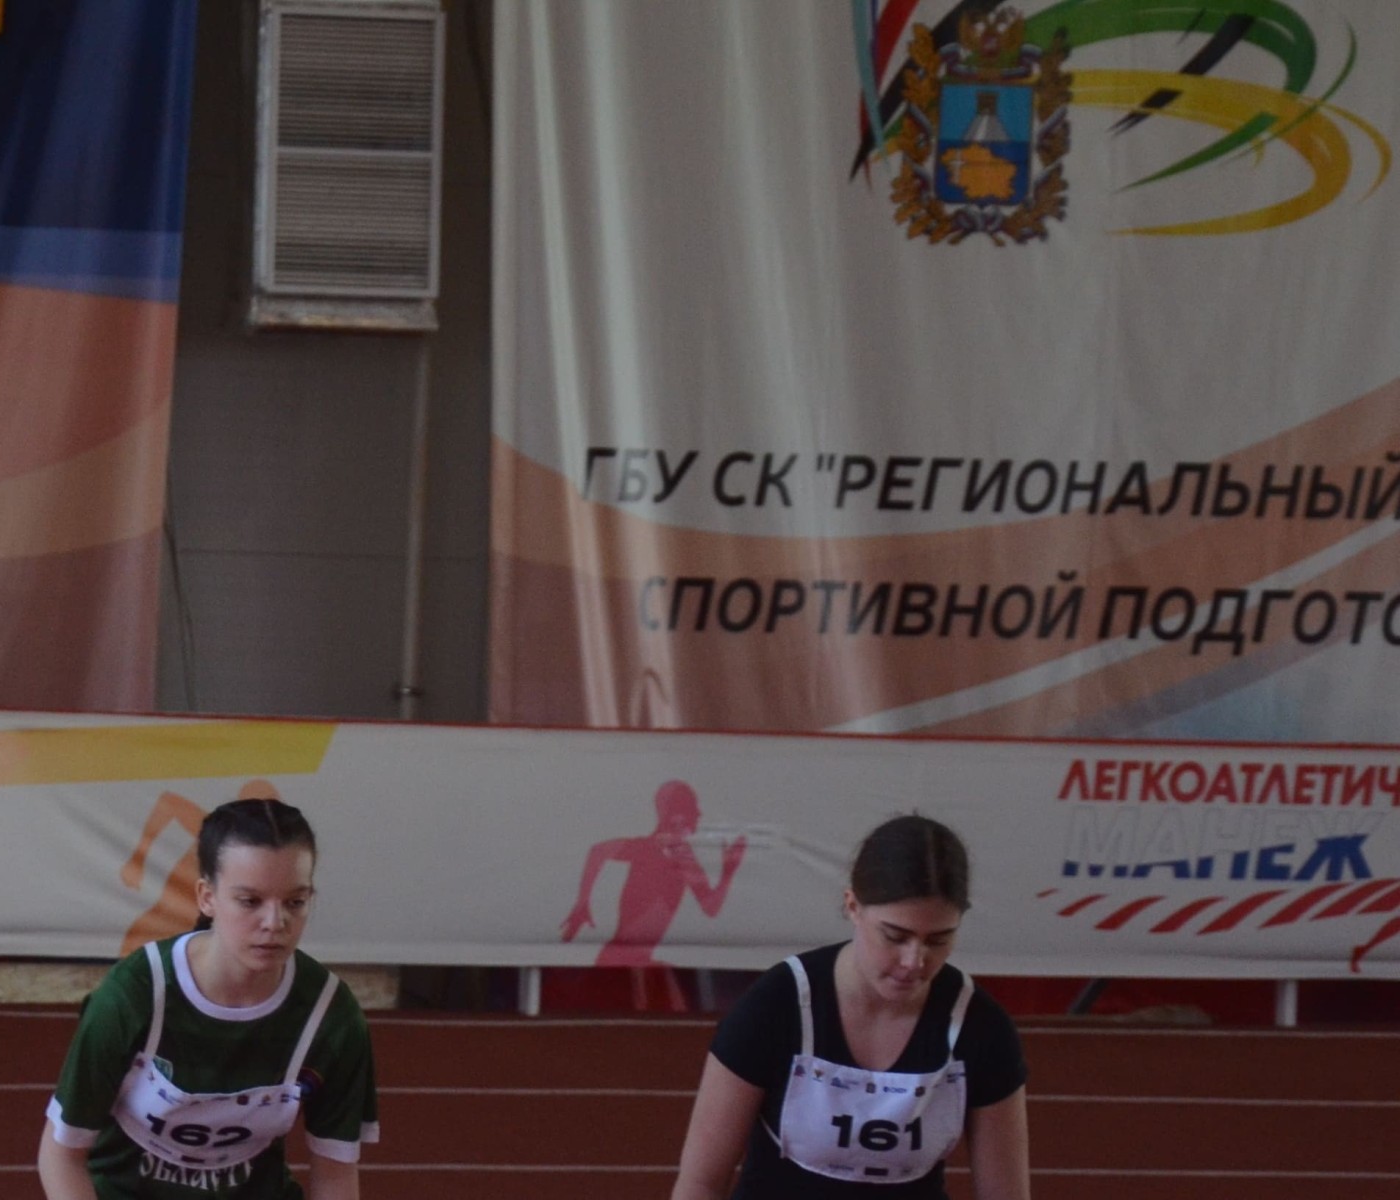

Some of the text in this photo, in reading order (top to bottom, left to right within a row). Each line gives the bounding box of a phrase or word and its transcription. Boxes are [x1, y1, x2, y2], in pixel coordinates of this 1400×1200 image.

[584, 446, 699, 503] ГБУ
[713, 451, 797, 507] СК
[639, 570, 1084, 642] СПОРТИВНОЙ
[146, 1113, 253, 1147] 162
[831, 1114, 923, 1151] 161
